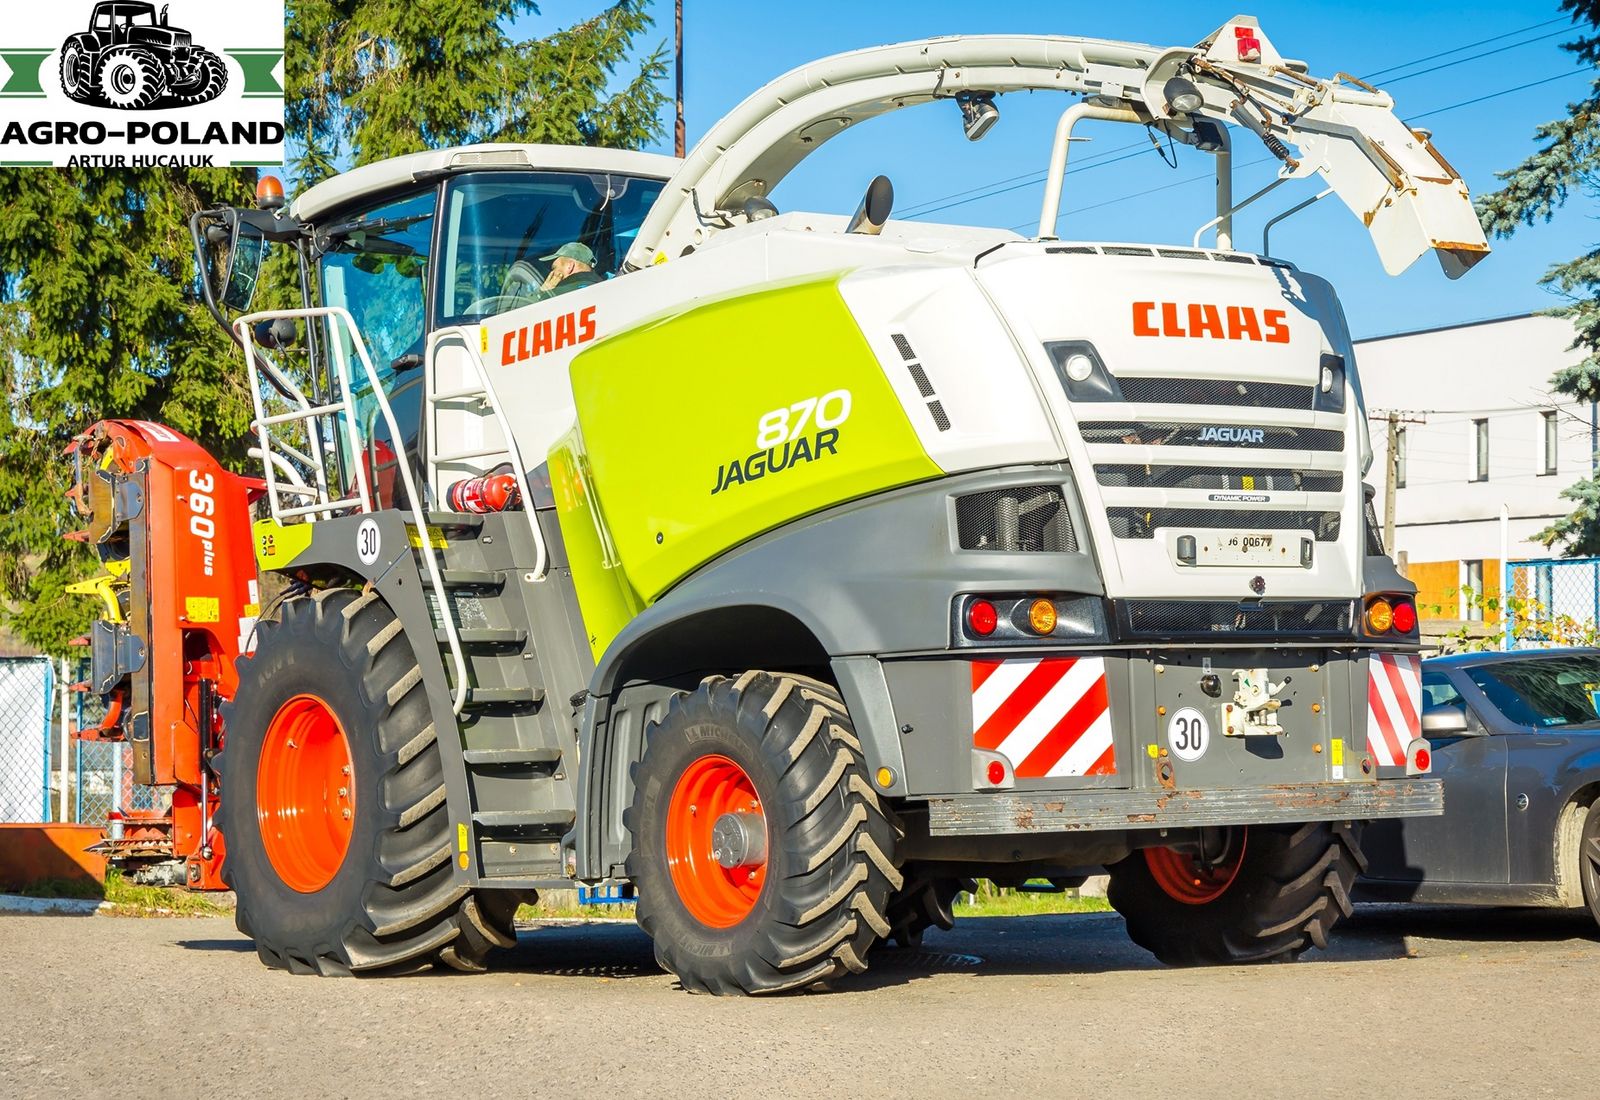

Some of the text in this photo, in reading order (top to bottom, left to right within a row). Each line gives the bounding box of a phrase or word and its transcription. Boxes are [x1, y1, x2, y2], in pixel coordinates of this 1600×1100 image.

[501, 305, 596, 366] CLAAS
[1132, 301, 1290, 344] CLAAS
[756, 388, 852, 450] 870
[1198, 427, 1264, 443] JAGUAR
[711, 428, 839, 495] JAGUAR
[361, 527, 376, 556] 30
[1243, 536, 1273, 548] 00677
[1175, 717, 1202, 751] 30
